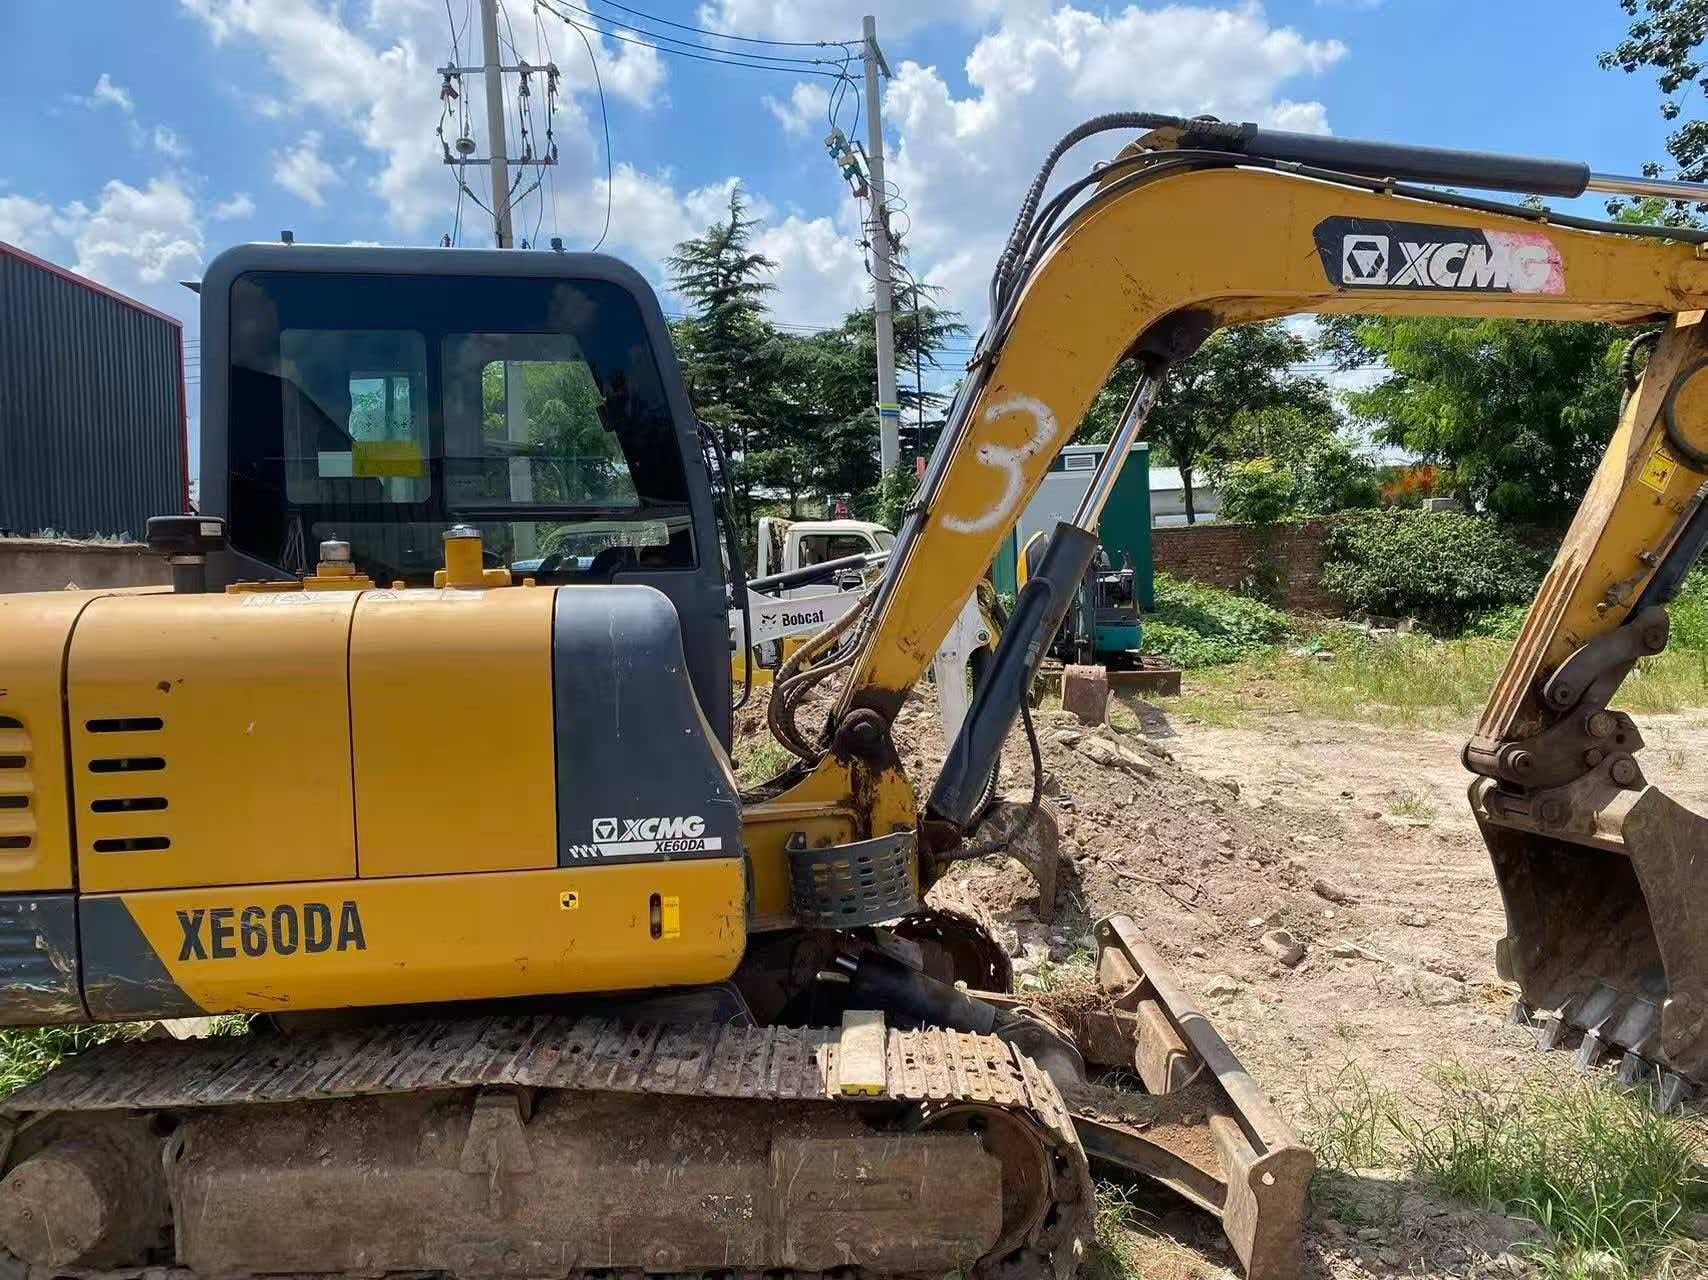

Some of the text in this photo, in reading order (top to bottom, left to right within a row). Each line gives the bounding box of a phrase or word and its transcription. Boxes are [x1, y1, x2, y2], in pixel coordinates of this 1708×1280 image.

[1388, 241, 1551, 292] XCMG
[940, 395, 1058, 534] 3
[782, 609, 824, 627] Bobcat
[619, 815, 706, 841] XCMG
[654, 839, 706, 853] XE60DA
[176, 900, 366, 961] XE60DA
